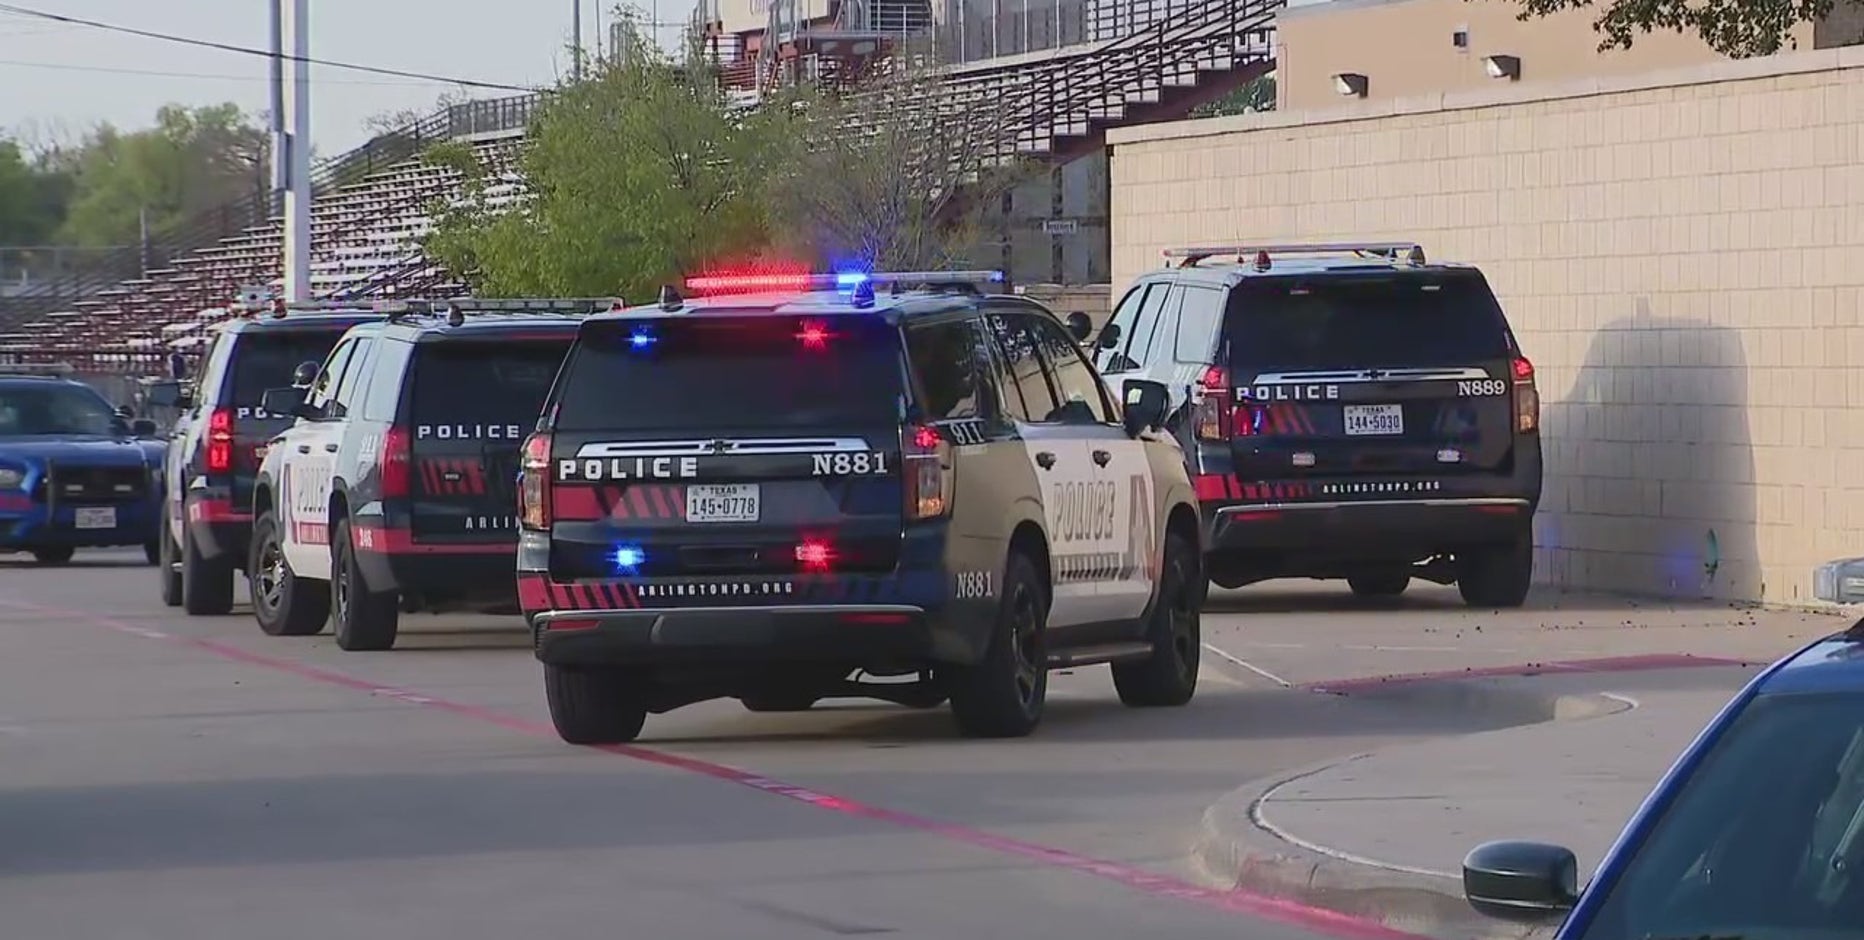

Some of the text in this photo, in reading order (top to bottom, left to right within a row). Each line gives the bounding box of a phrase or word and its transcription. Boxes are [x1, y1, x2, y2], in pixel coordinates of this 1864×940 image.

[1236, 385, 1338, 401] POLICE
[1457, 380, 1505, 396] N889
[417, 425, 520, 439] POLICE
[950, 422, 985, 445] 911
[560, 457, 697, 480] POLICE
[812, 452, 888, 475] N881
[709, 486, 738, 495] TEXAS
[1322, 481, 1440, 494] ARLINGTONPD.ORG
[1053, 480, 1116, 542] POLICE
[638, 582, 793, 597] ARLINGTONPD.ORG
[956, 571, 993, 599] N881
